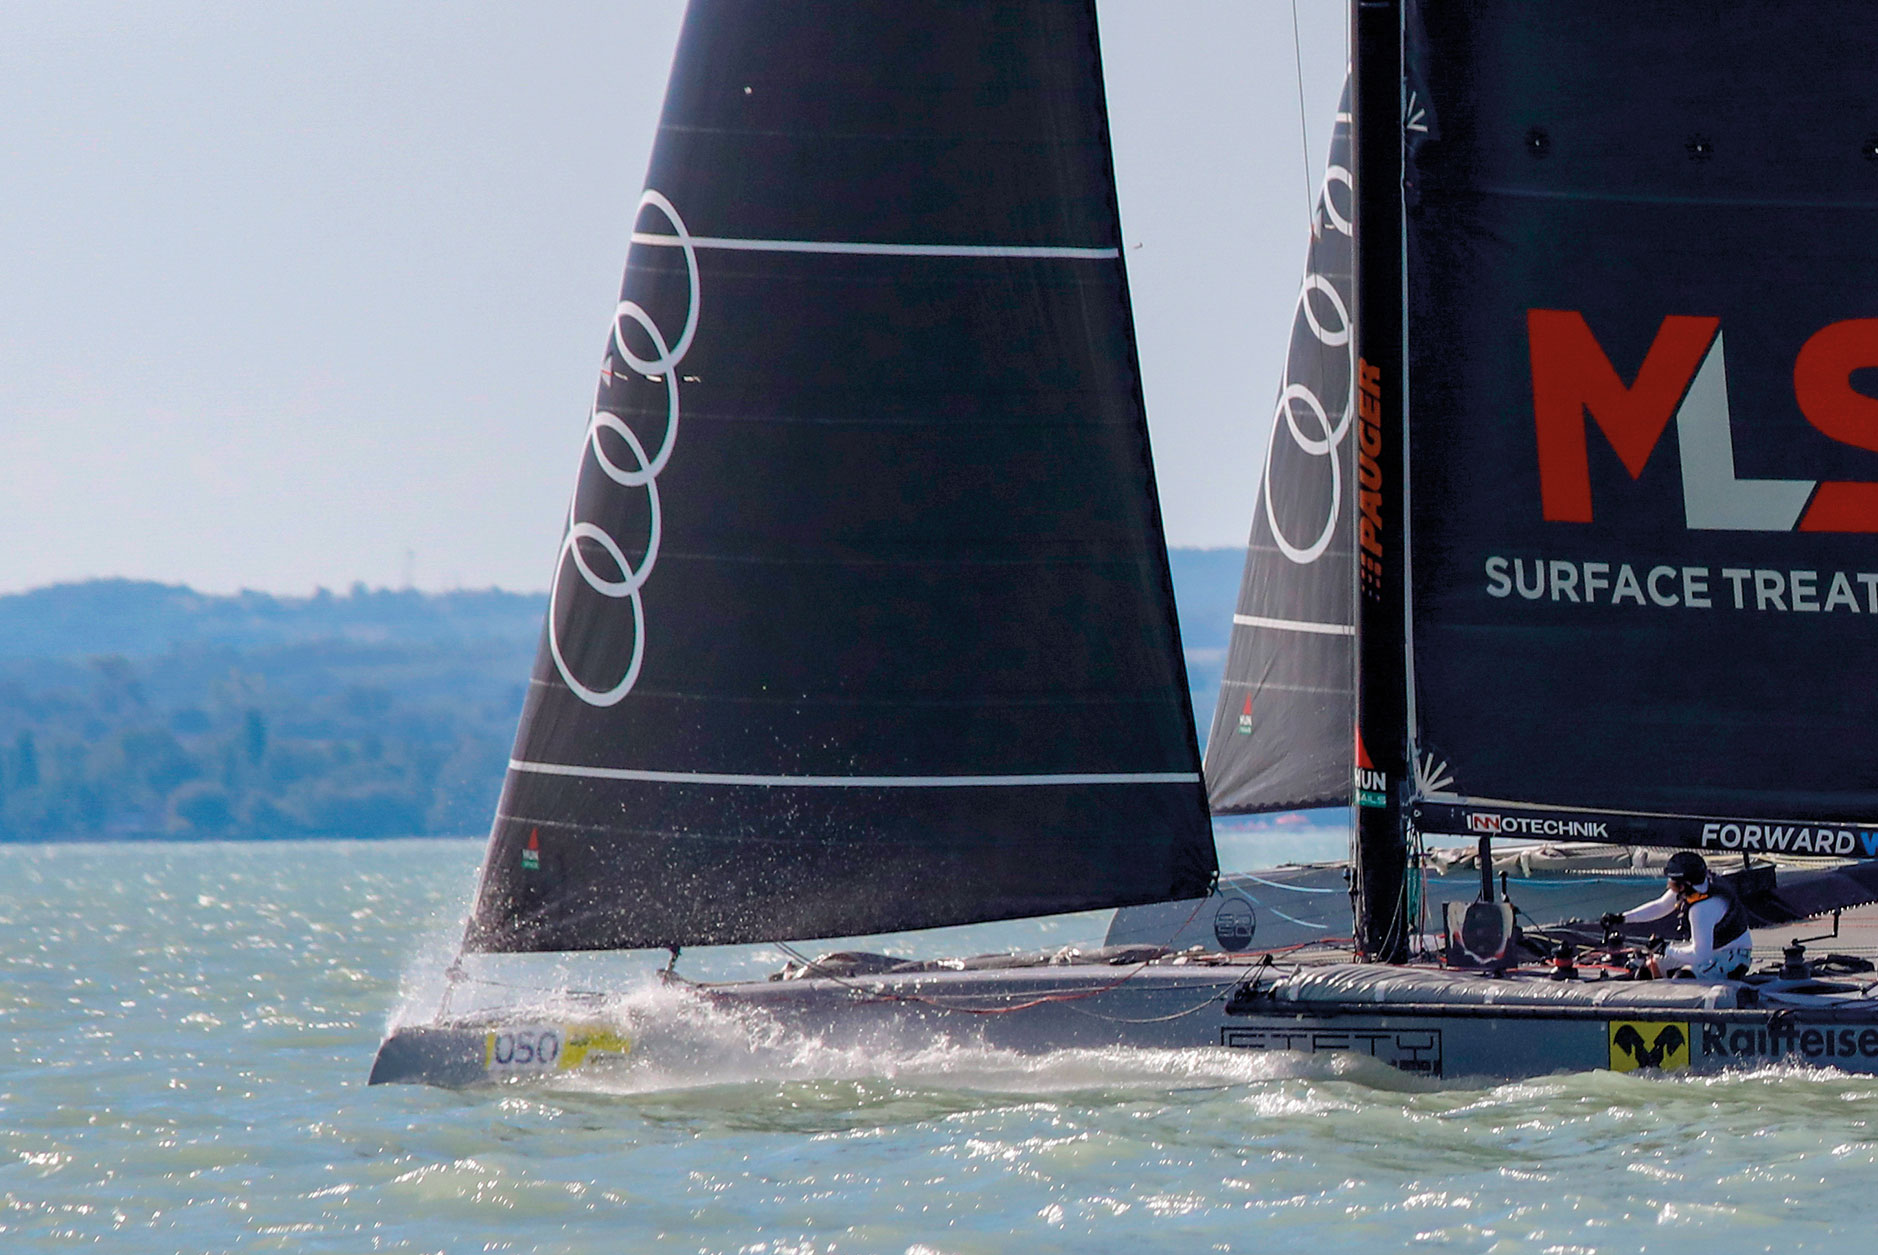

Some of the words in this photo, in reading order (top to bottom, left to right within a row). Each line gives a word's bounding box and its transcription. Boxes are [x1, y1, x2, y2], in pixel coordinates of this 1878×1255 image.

[1359, 357, 1383, 558] PAUGER
[1484, 556, 1712, 608] SURFACE
[1355, 767, 1386, 791] HUN
[1466, 812, 1608, 838] INNOTECHNIK
[1701, 823, 1855, 854] FORWARD
